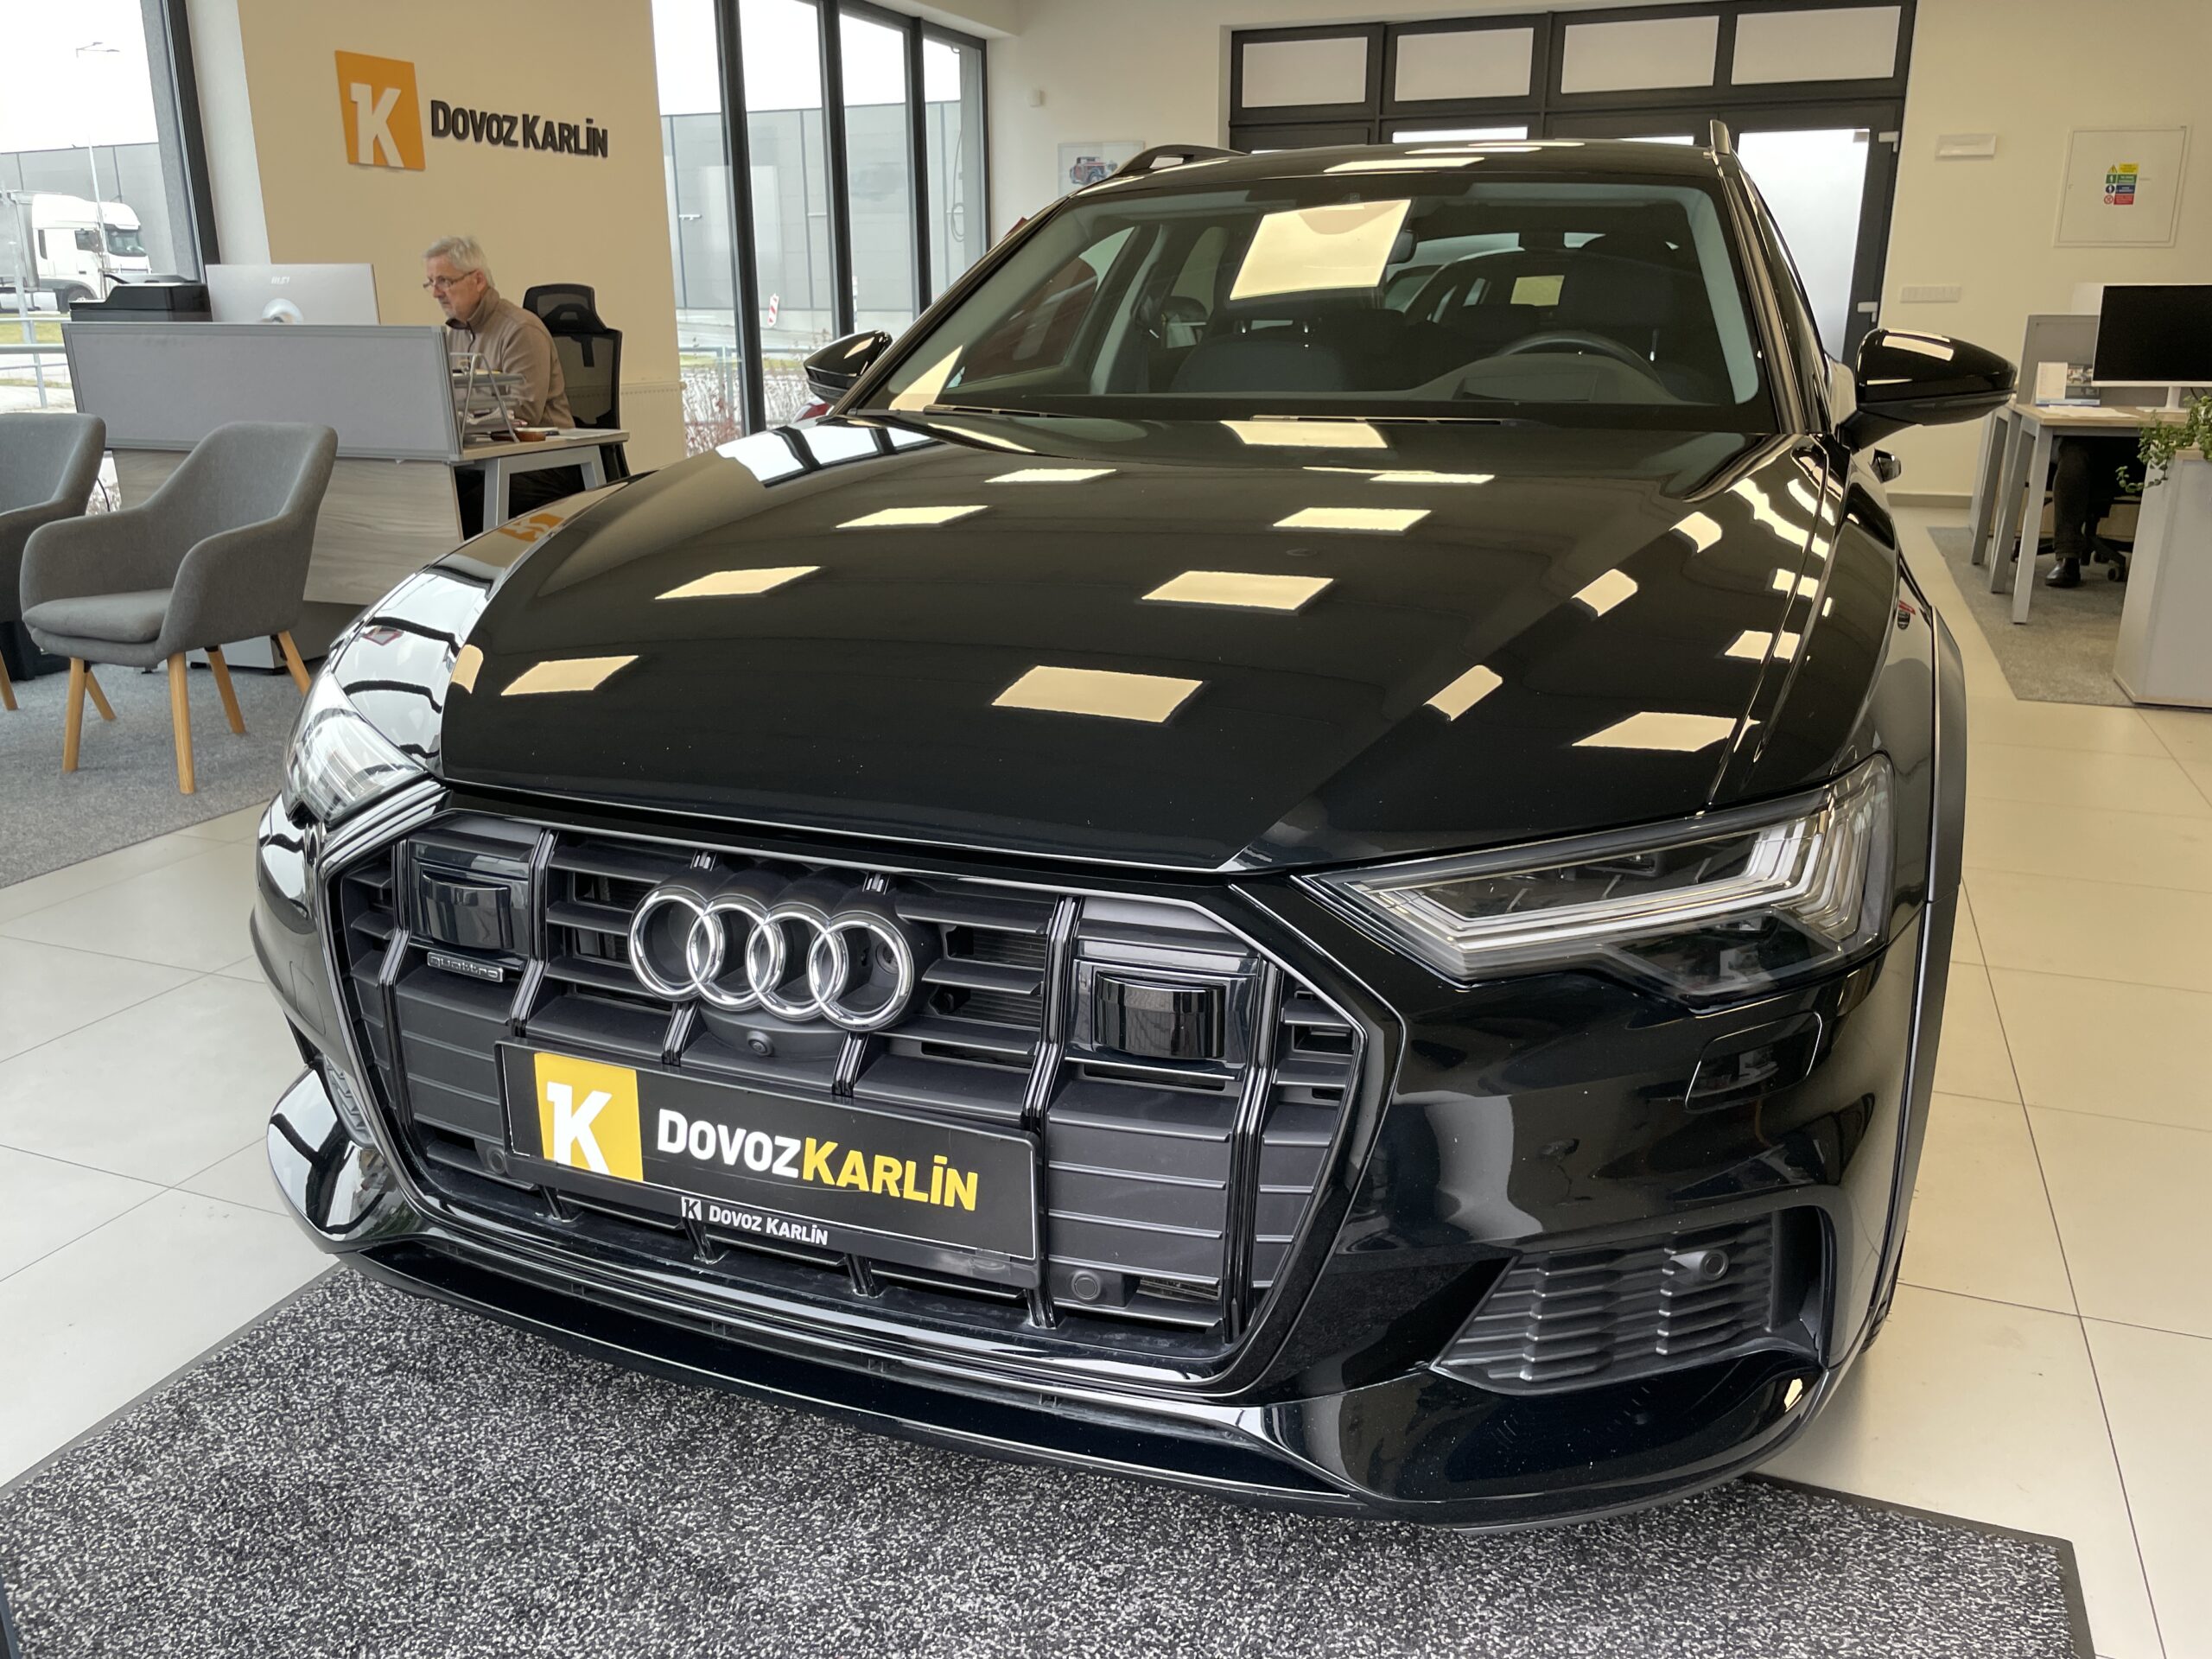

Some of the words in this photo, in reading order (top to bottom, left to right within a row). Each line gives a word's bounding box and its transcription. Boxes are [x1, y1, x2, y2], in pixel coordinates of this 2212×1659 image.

[430, 99, 519, 147] DOVOZ
[430, 956, 499, 978] quattro
[709, 1205, 761, 1231] DOVOZ
